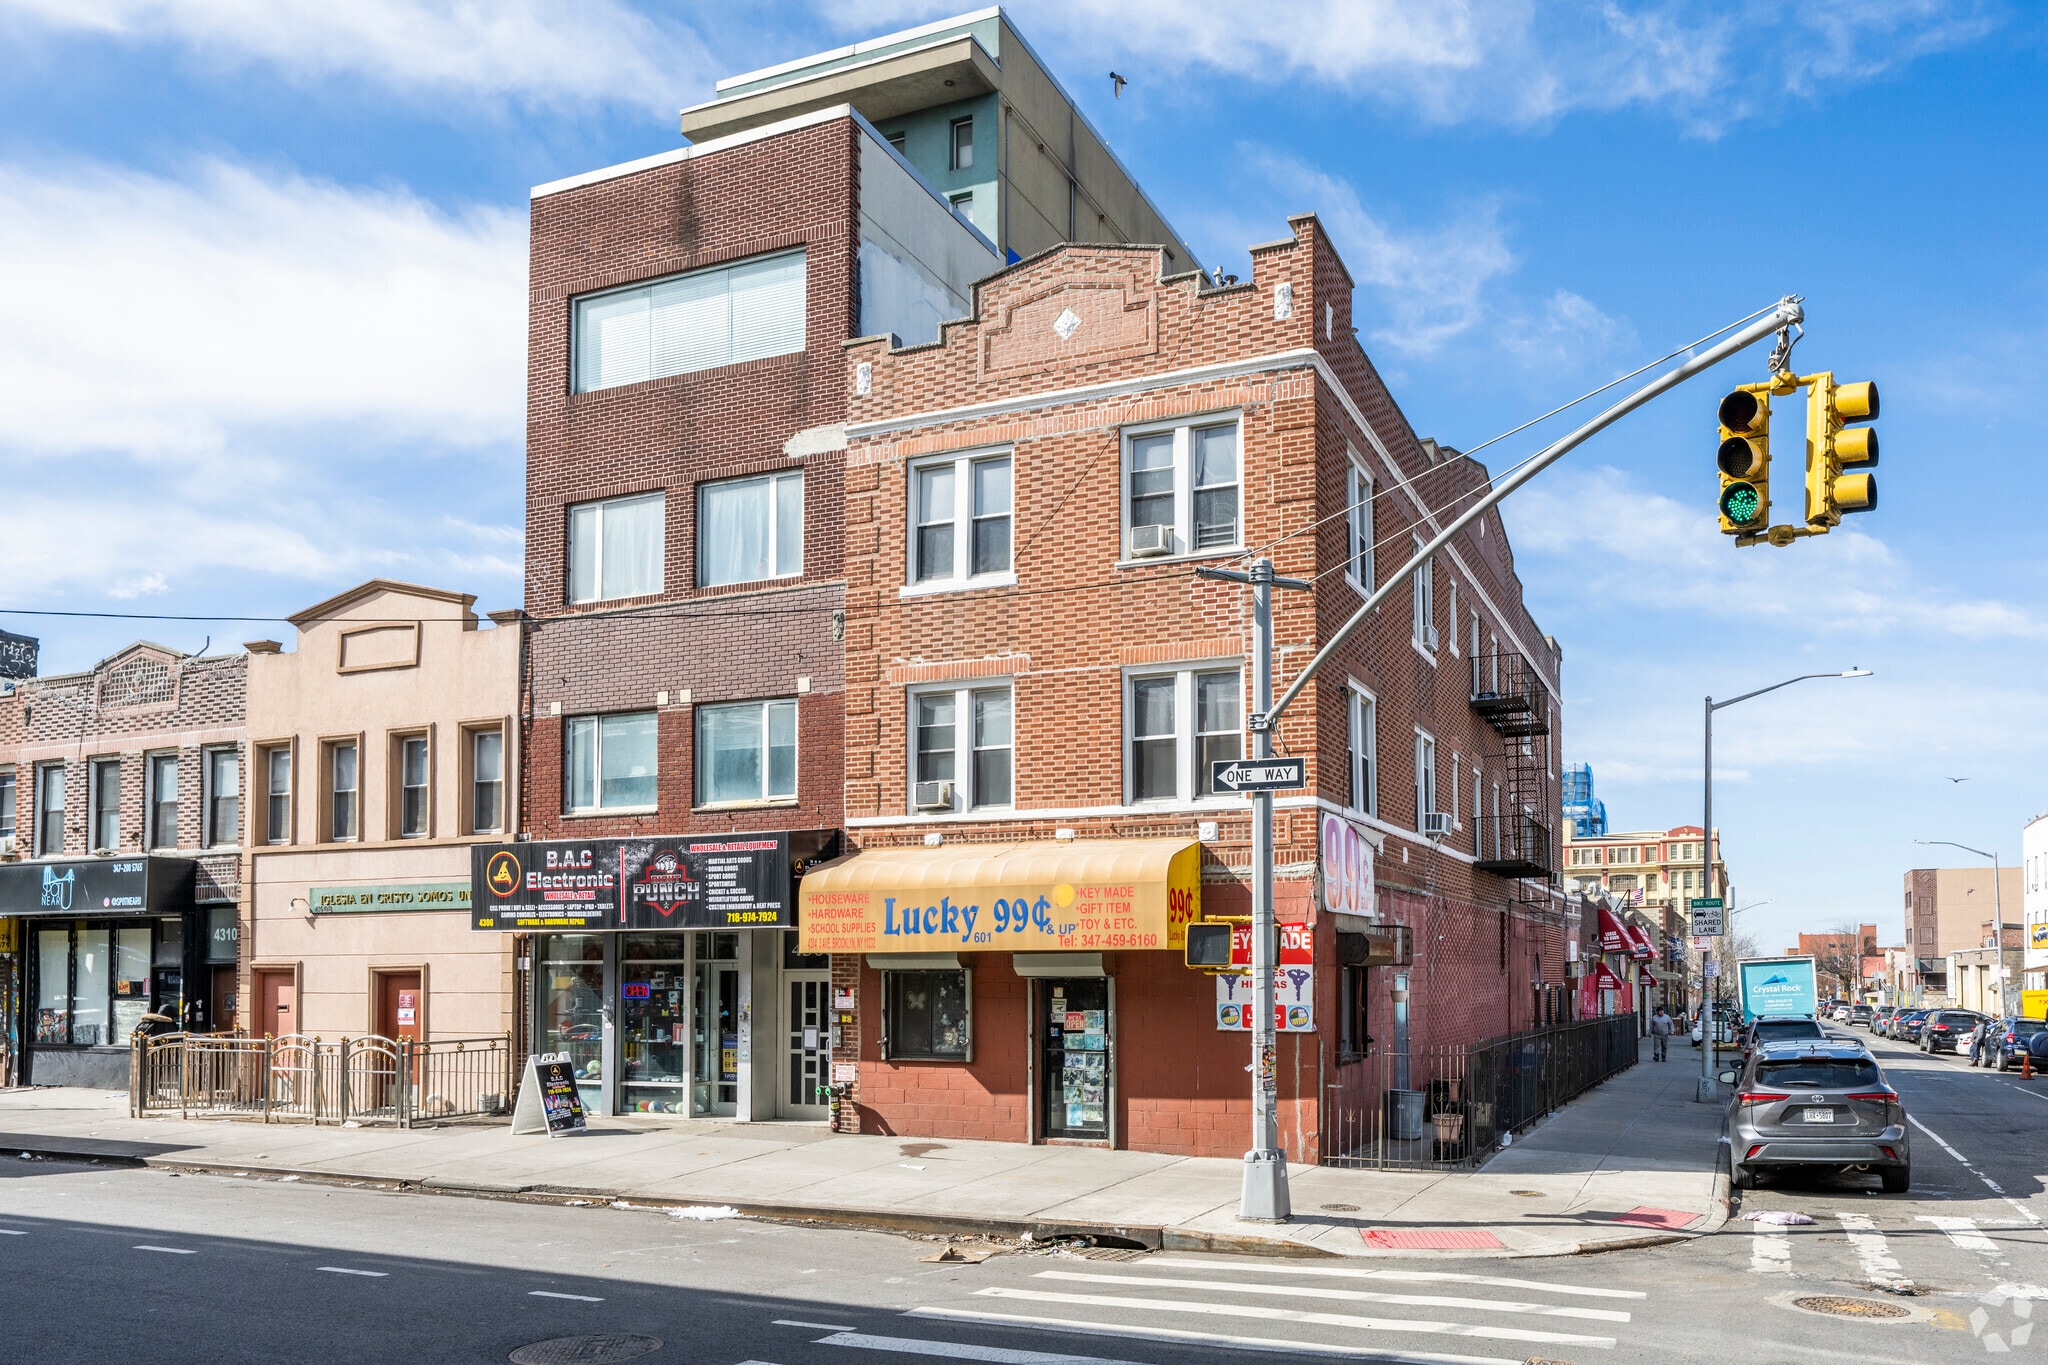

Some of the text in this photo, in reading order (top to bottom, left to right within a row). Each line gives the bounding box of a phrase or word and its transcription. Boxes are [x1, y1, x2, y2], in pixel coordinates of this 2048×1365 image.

[1226, 768, 1292, 783] ONE WAY
[690, 843, 721, 853] WHOLESALE
[727, 842, 745, 851] RETAIL
[745, 840, 777, 851] EQUIPMENT
[546, 849, 592, 869] B.A.C
[526, 870, 615, 890] Electronic
[651, 874, 681, 884] RIGHT
[320, 892, 357, 906] IGLESIA
[360, 893, 373, 905] EN
[376, 891, 414, 904] CRISTO
[417, 890, 454, 903] SOMOS
[544, 892, 573, 900] WHOLESALE
[633, 882, 700, 902] PUNCH
[1080, 886, 1135, 899] KEY MADE
[41, 897, 62, 906] NEAR
[1080, 902, 1131, 914] GIFT ITEM
[1169, 887, 1193, 924] 99¢
[726, 911, 777, 923] 718-974-7924
[884, 895, 1051, 943] Lucky 99¢
[1080, 917, 1138, 930] TOY & ETC.
[1694, 919, 1721, 927] SHARED
[214, 928, 237, 941] 4310
[810, 922, 876, 934] SCHOOL SUPPLIES
[1046, 924, 1076, 935] & UP
[974, 932, 992, 943] 601
[1058, 933, 1157, 948] Tel: 347-459-6160
[1281, 932, 1311, 950] ADE
[625, 985, 648, 997] OPEN
[1753, 984, 1801, 995] Crystal Rock
[1066, 1019, 1085, 1028] OPEN
